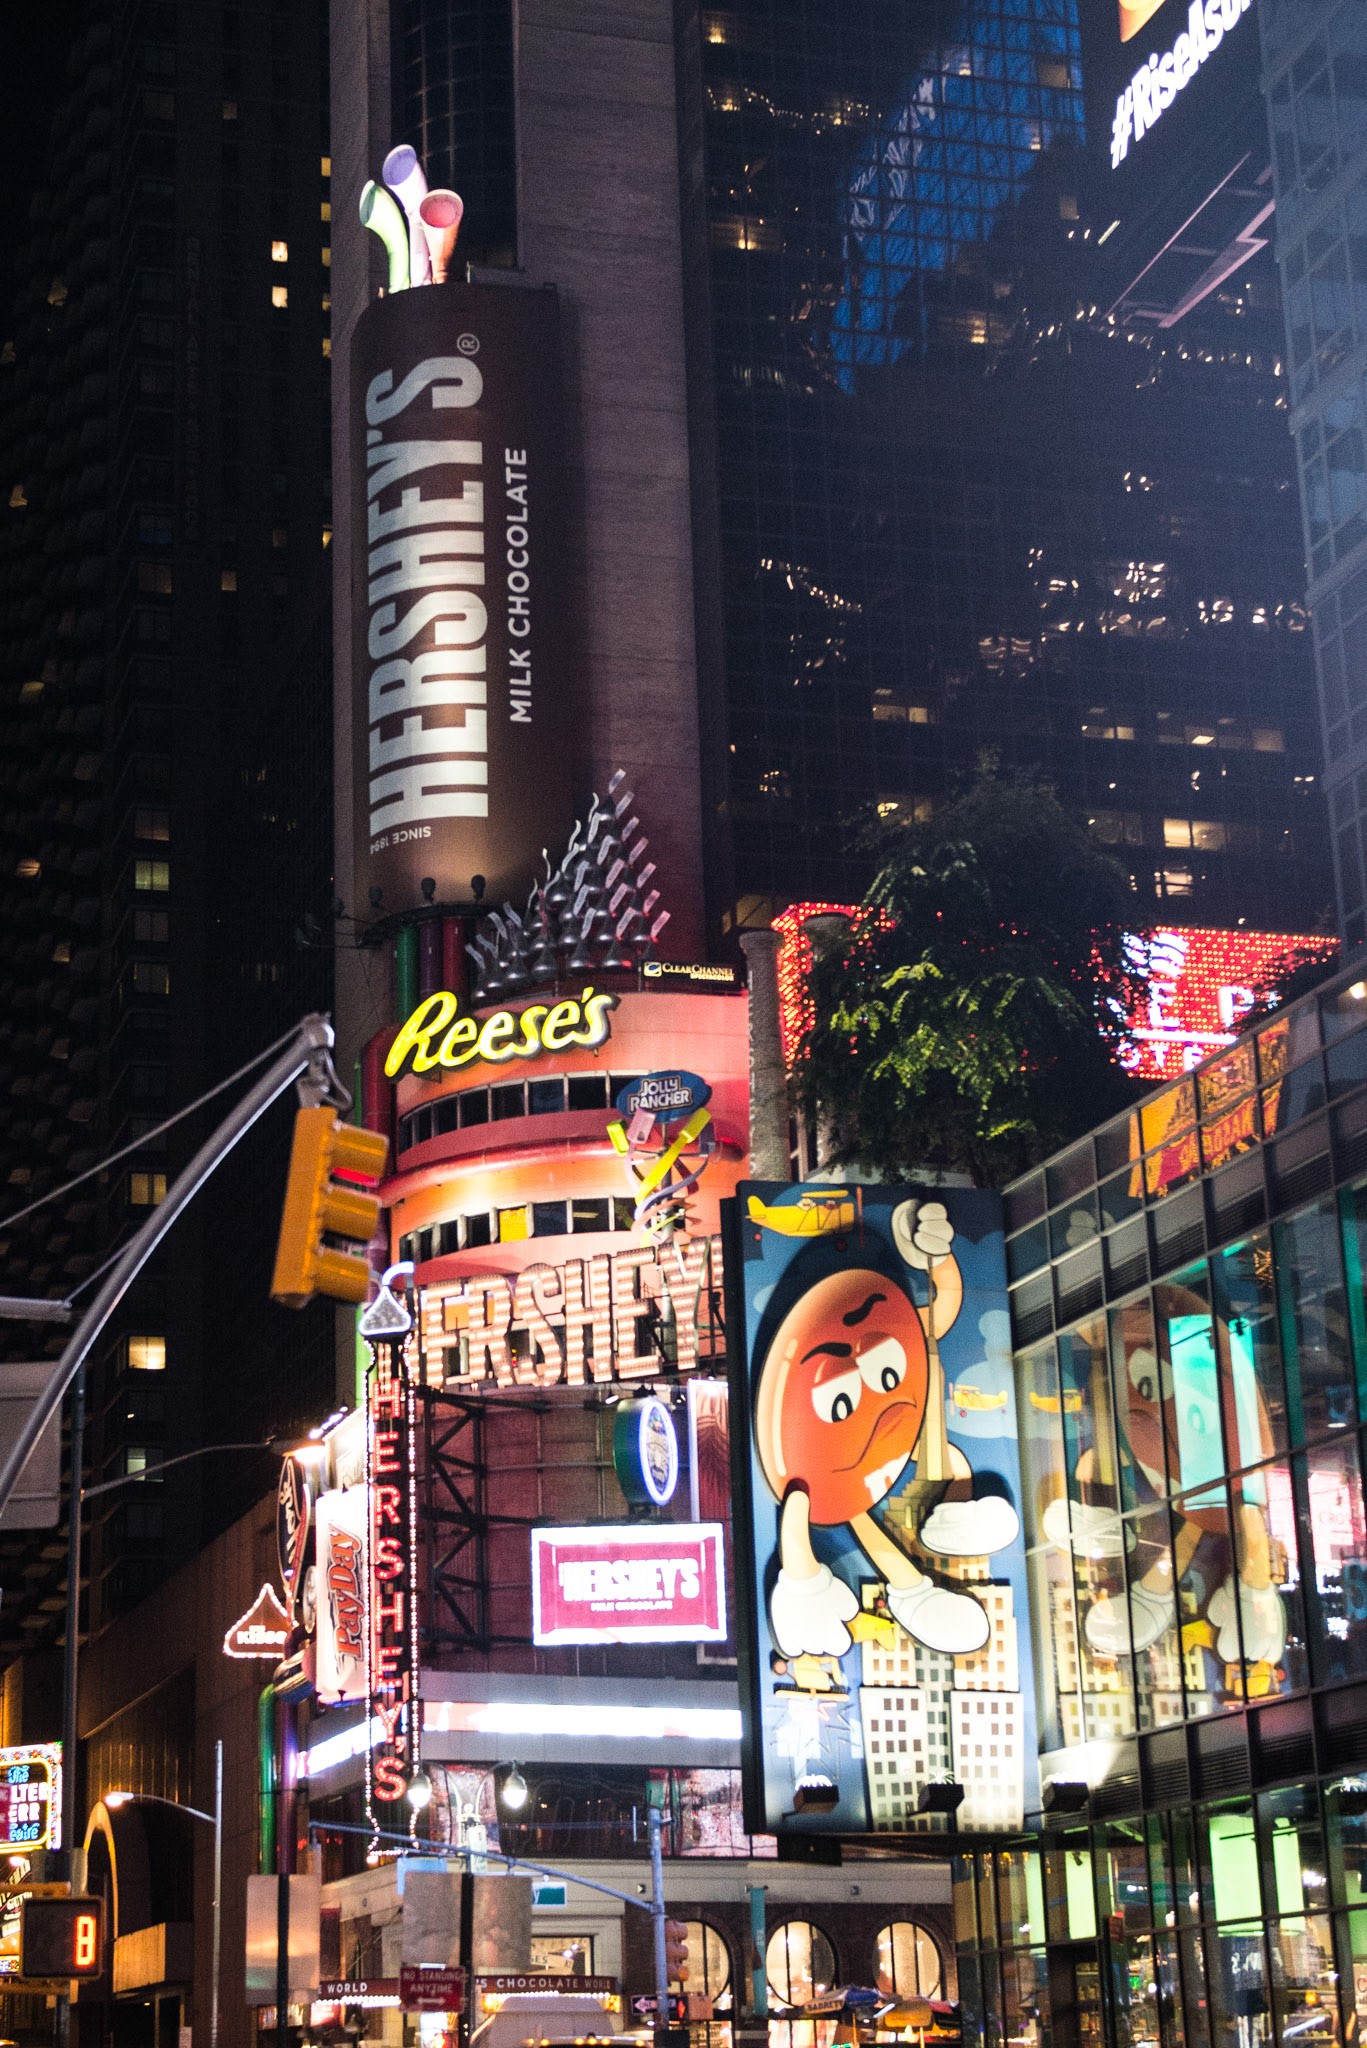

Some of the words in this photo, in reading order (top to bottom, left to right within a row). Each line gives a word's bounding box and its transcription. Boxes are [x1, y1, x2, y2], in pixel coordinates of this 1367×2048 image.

[505, 448, 531, 637] CHOCOLATE
[366, 357, 489, 837] HERSHEY'S
[509, 648, 532, 722] MILK
[369, 837, 389, 855] 1894
[392, 826, 432, 845] SINCE
[384, 986, 613, 1078] Reese's
[641, 1077, 680, 1098] JOLLY
[629, 1089, 690, 1113] RANCHER
[327, 1523, 364, 1662] PayDay
[371, 1377, 408, 1800] HERSHEY'S
[8, 1764, 30, 1785] The
[10, 1782, 49, 1803] LTER
[8, 1802, 40, 1823] ERR
[74, 1914, 97, 1968] 8
[403, 1970, 417, 1980] NO
[496, 1978, 579, 1989] CHOCOLATE
[584, 1980, 611, 1990] WORLD
[327, 1982, 368, 1993] WORLD
